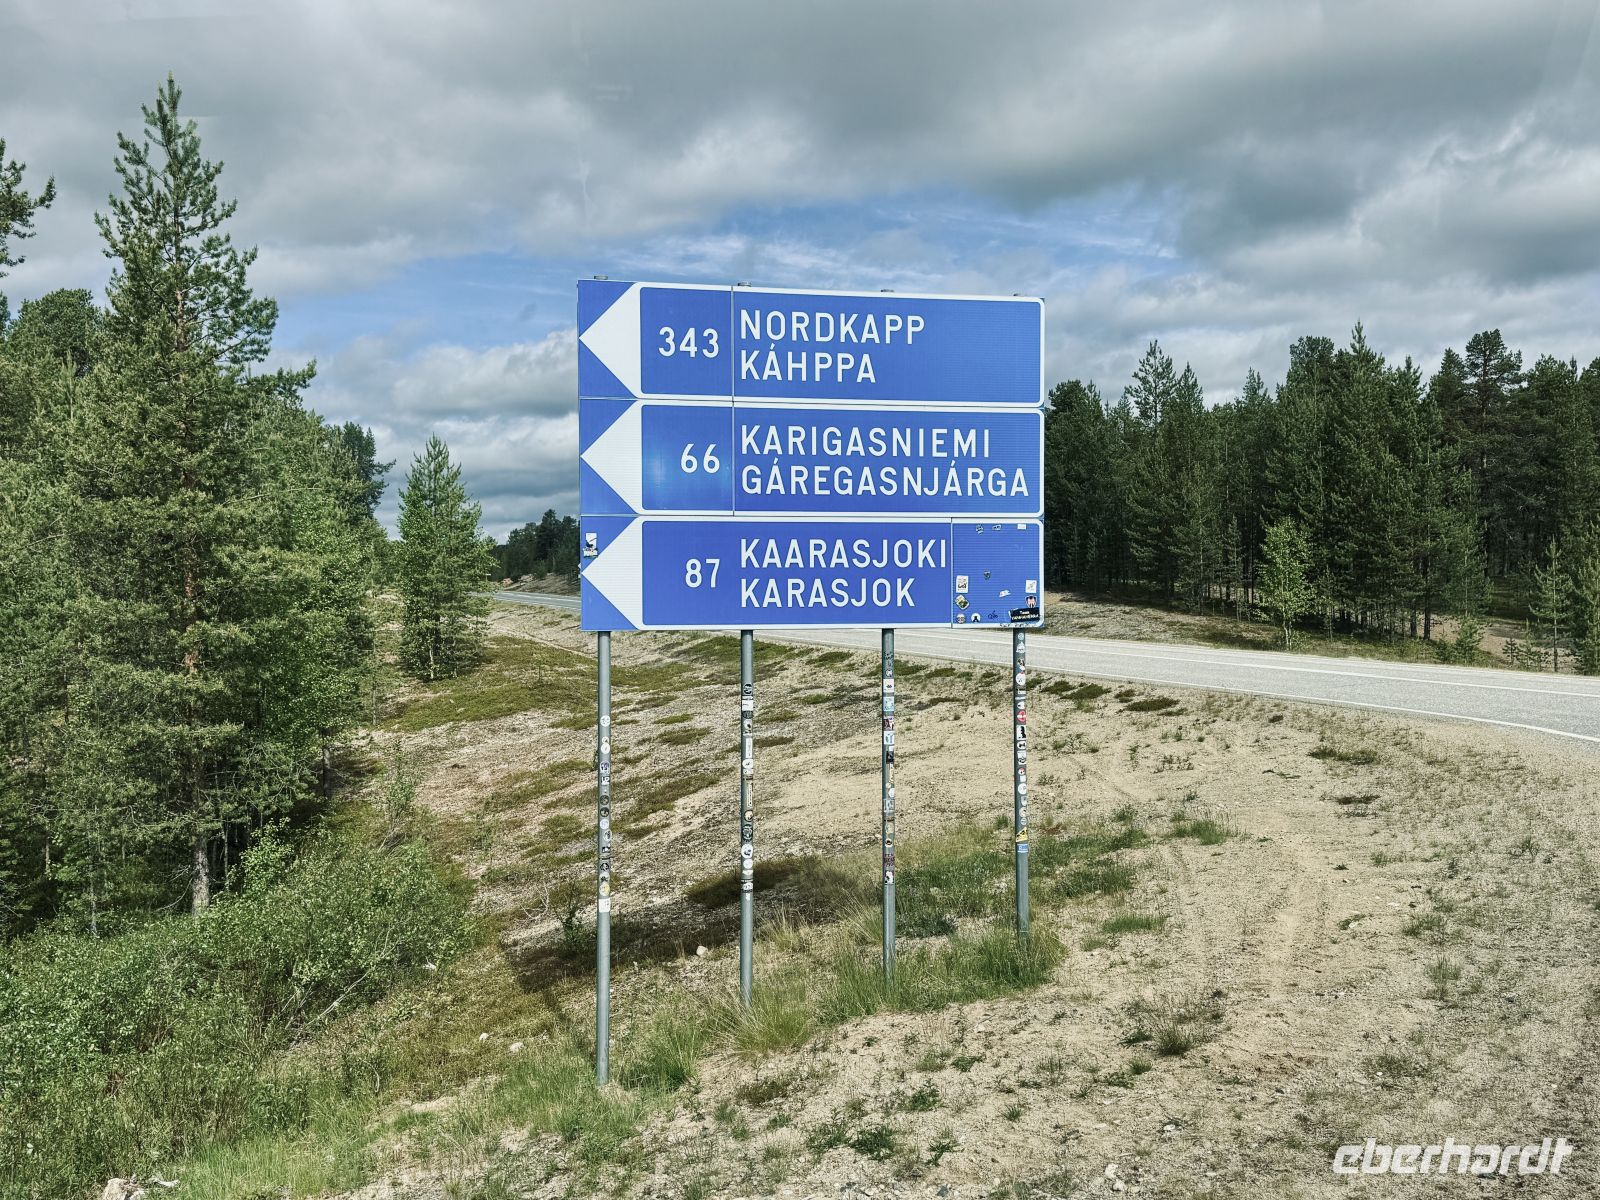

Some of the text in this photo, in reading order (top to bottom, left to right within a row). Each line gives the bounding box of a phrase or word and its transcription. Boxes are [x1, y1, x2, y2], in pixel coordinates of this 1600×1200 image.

[658, 326, 719, 358] 343
[740, 309, 925, 345] NORDKAPP
[741, 343, 876, 383] KÁHPPA
[741, 424, 989, 458] KARIGASNIEMI
[680, 443, 720, 474] 66
[742, 458, 1029, 497] GÁREGASNJÁRGA
[741, 538, 946, 568] KAARASJOKI
[685, 558, 720, 588] 87
[741, 578, 915, 608] KARASJOK
